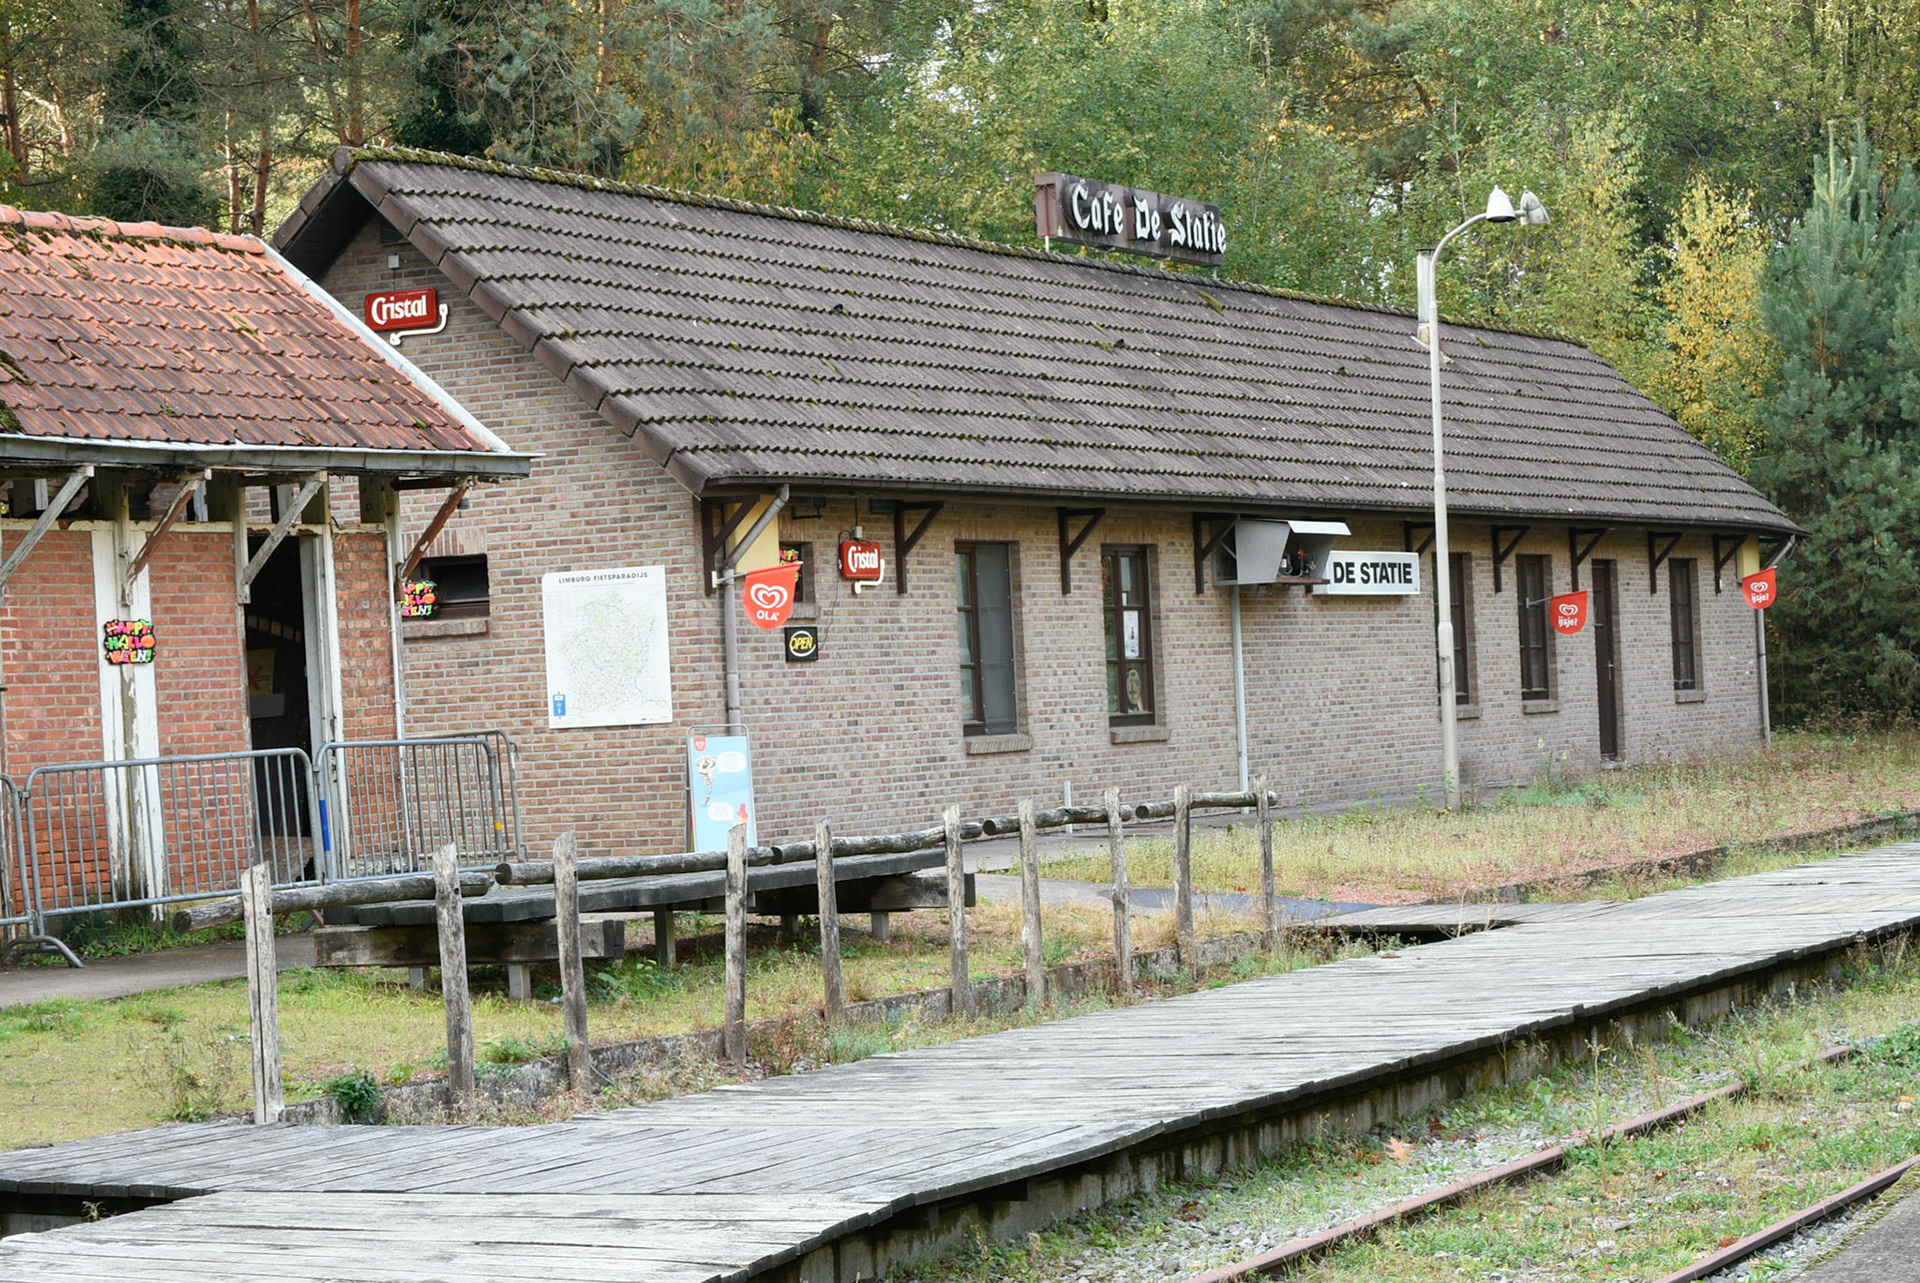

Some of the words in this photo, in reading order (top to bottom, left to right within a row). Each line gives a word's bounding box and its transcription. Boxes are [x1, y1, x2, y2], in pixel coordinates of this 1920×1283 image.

[1134, 195, 1161, 240] De
[1168, 203, 1227, 254] Statie
[371, 295, 427, 325] Cristal
[848, 546, 878, 573] Cristal
[558, 575, 591, 584] LIMBURG
[593, 571, 649, 582] FIETSPARADIJS
[1333, 562, 1356, 584] DE
[1360, 562, 1413, 585] STATIE
[756, 610, 778, 621] OLA
[1558, 615, 1579, 628] ijsje?
[106, 621, 152, 636] HAPPY
[108, 634, 156, 650] HALLO
[789, 636, 813, 650] OPEN
[108, 649, 152, 664] WEEN!
